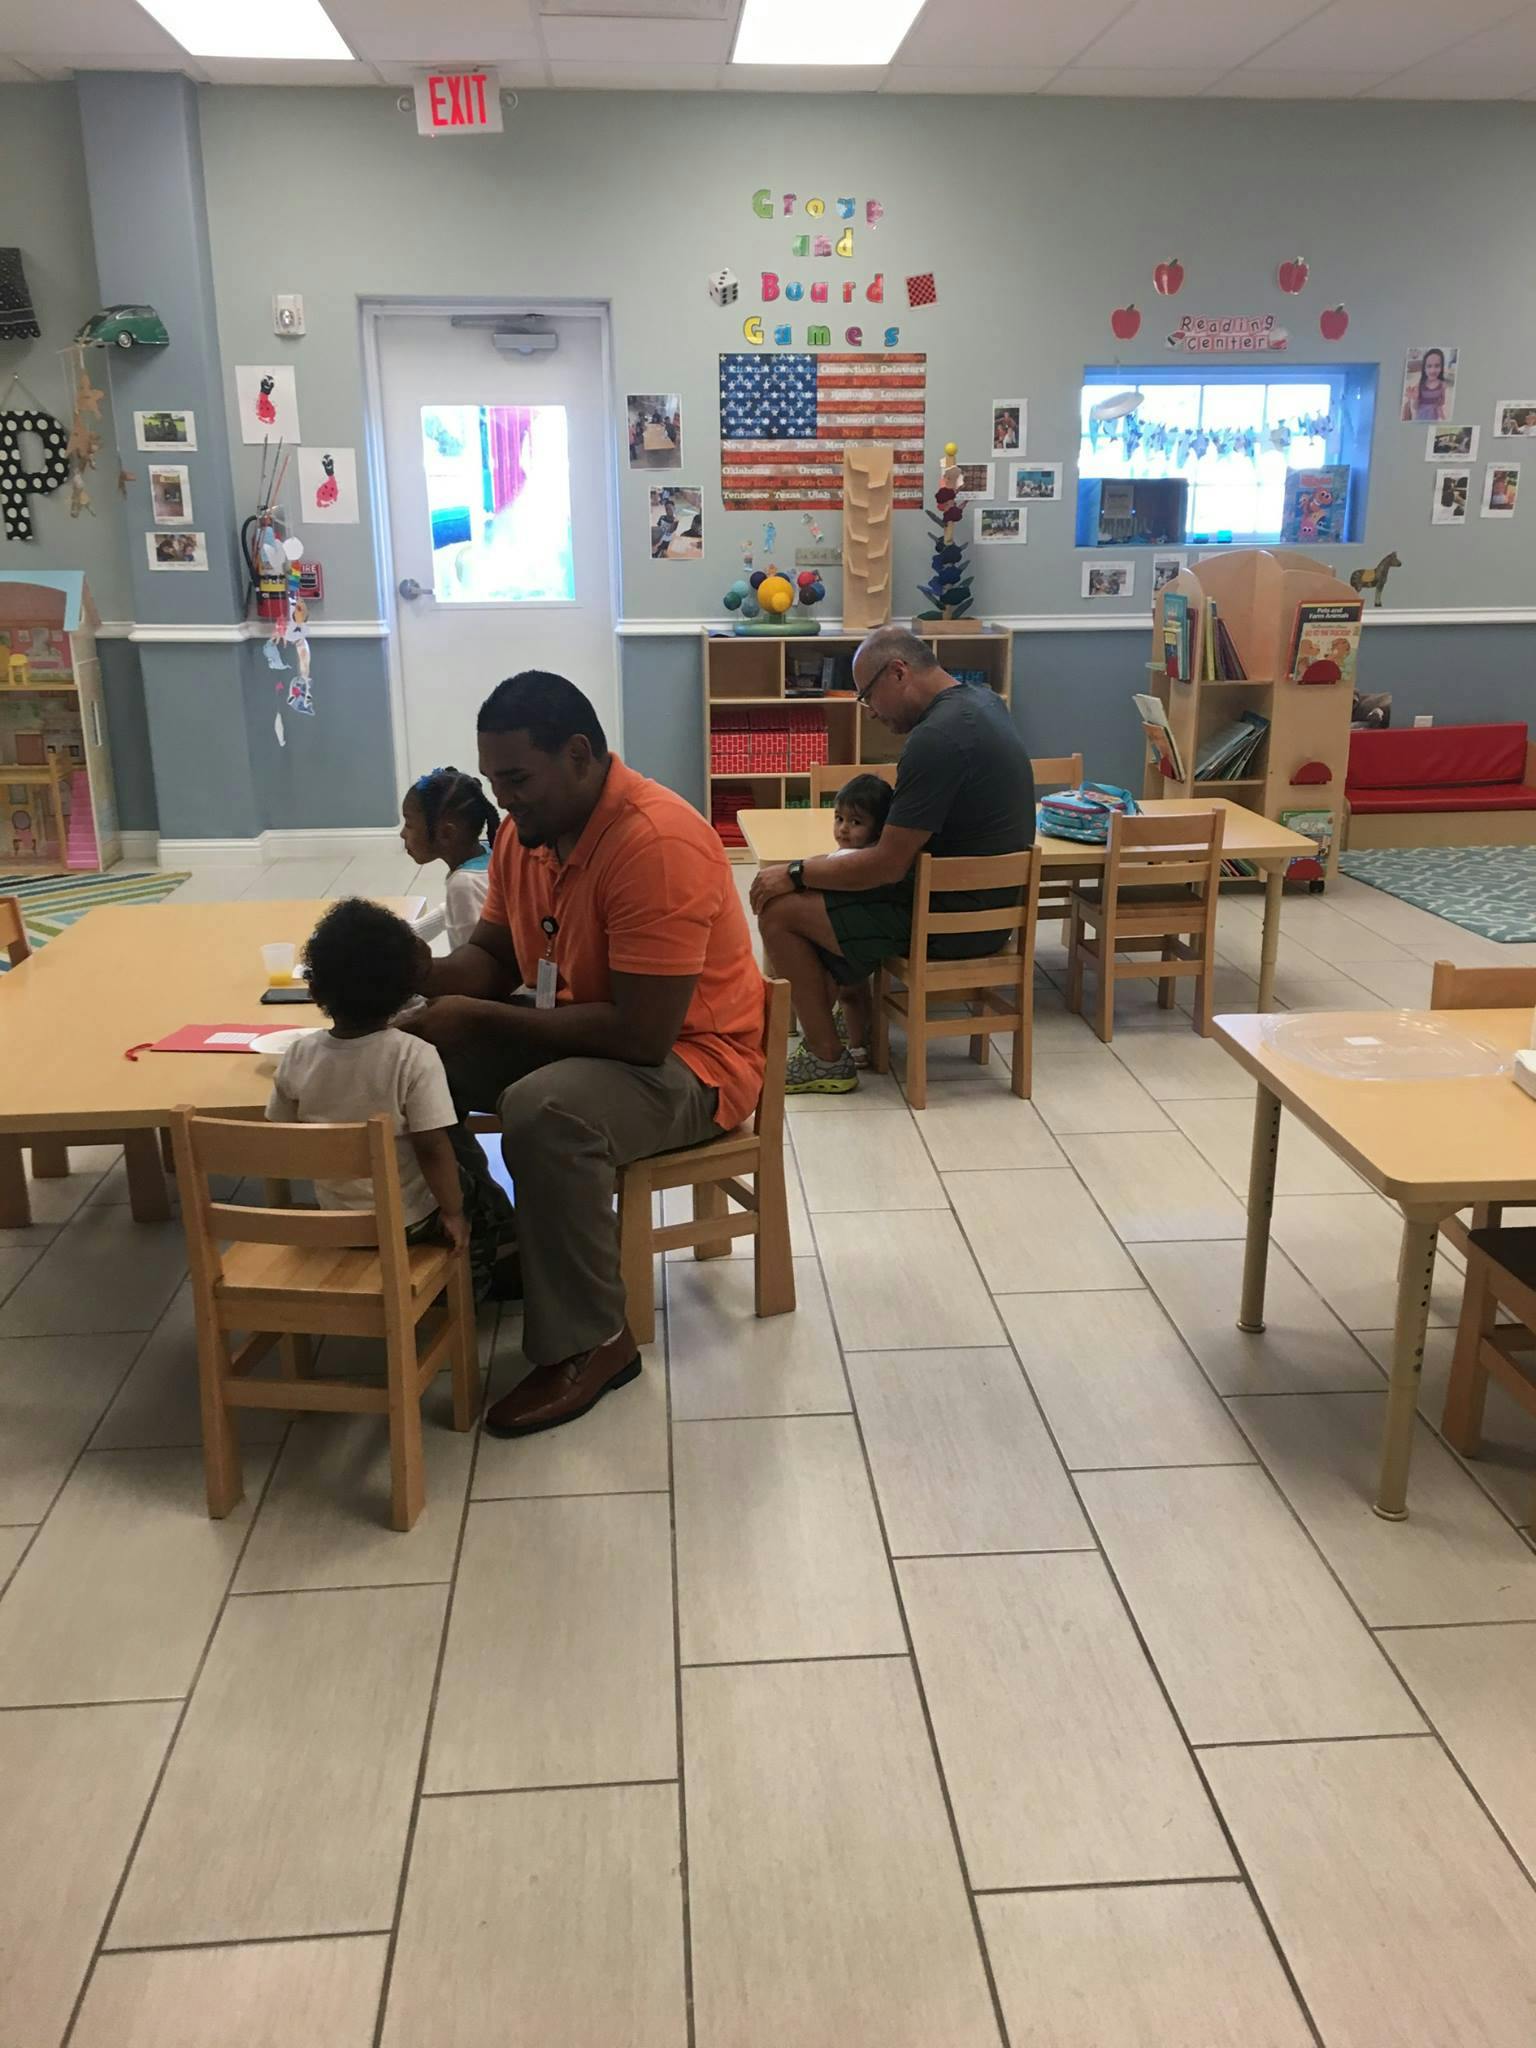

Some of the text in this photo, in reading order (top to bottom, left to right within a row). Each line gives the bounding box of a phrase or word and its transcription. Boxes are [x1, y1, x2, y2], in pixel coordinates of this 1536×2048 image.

[428, 74, 487, 126] EXIT
[760, 271, 884, 304] Board
[743, 315, 900, 347] Games
[1180, 313, 1275, 332] Reading
[1186, 336, 1266, 350] Center
[722, 441, 745, 449] New
